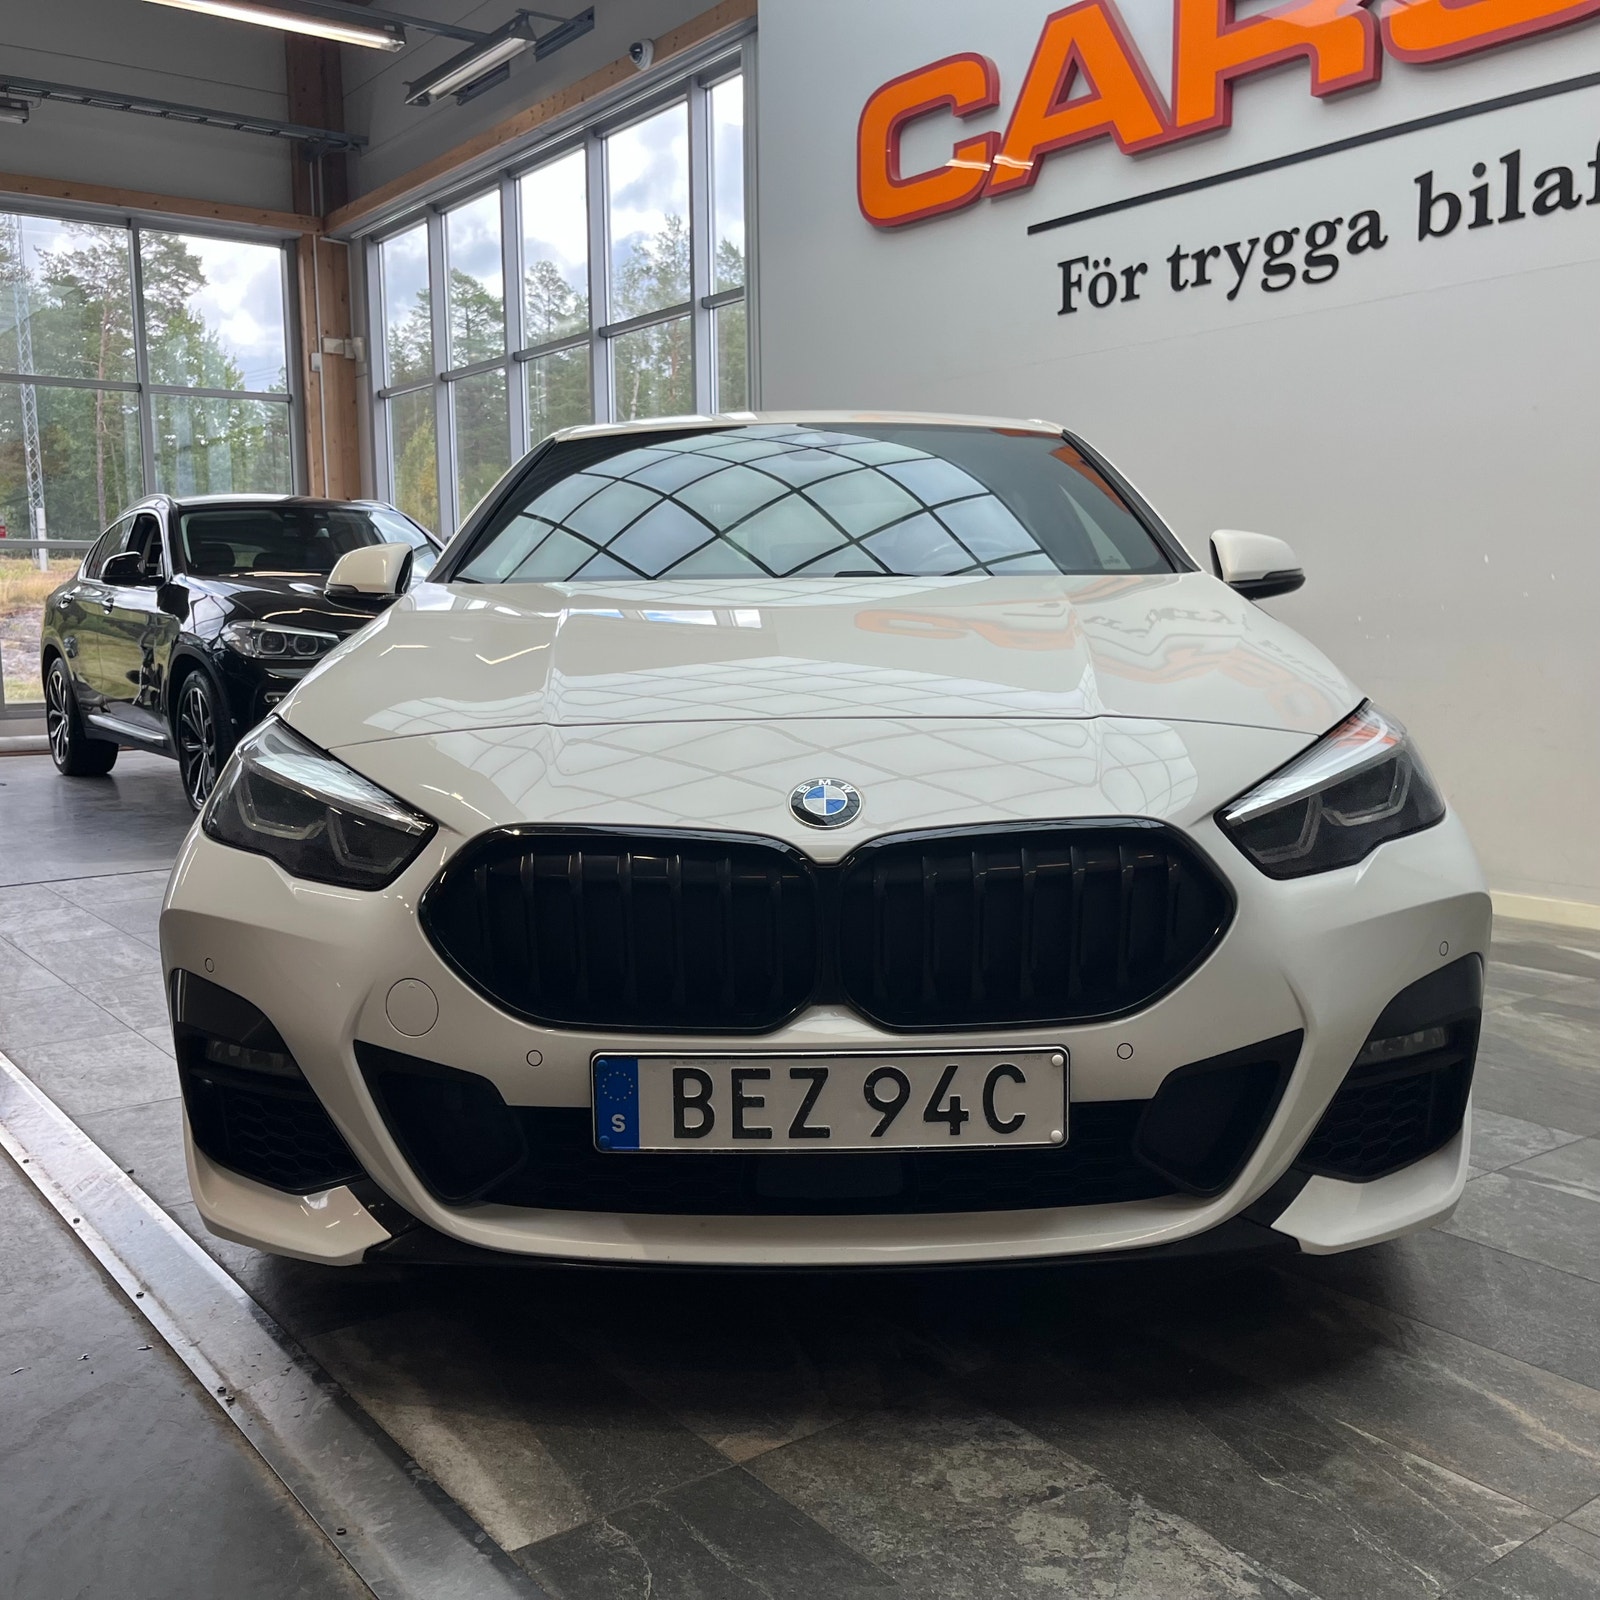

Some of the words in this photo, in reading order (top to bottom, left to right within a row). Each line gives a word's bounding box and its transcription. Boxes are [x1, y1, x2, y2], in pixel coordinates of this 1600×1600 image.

[857, 0, 1600, 227] CAR
[1057, 254, 1148, 315] För
[1166, 207, 1388, 301] trygga
[797, 779, 855, 793] BMW
[611, 1113, 626, 1133] S
[672, 1067, 831, 1139] BEZ
[863, 1063, 1027, 1138] 94C
